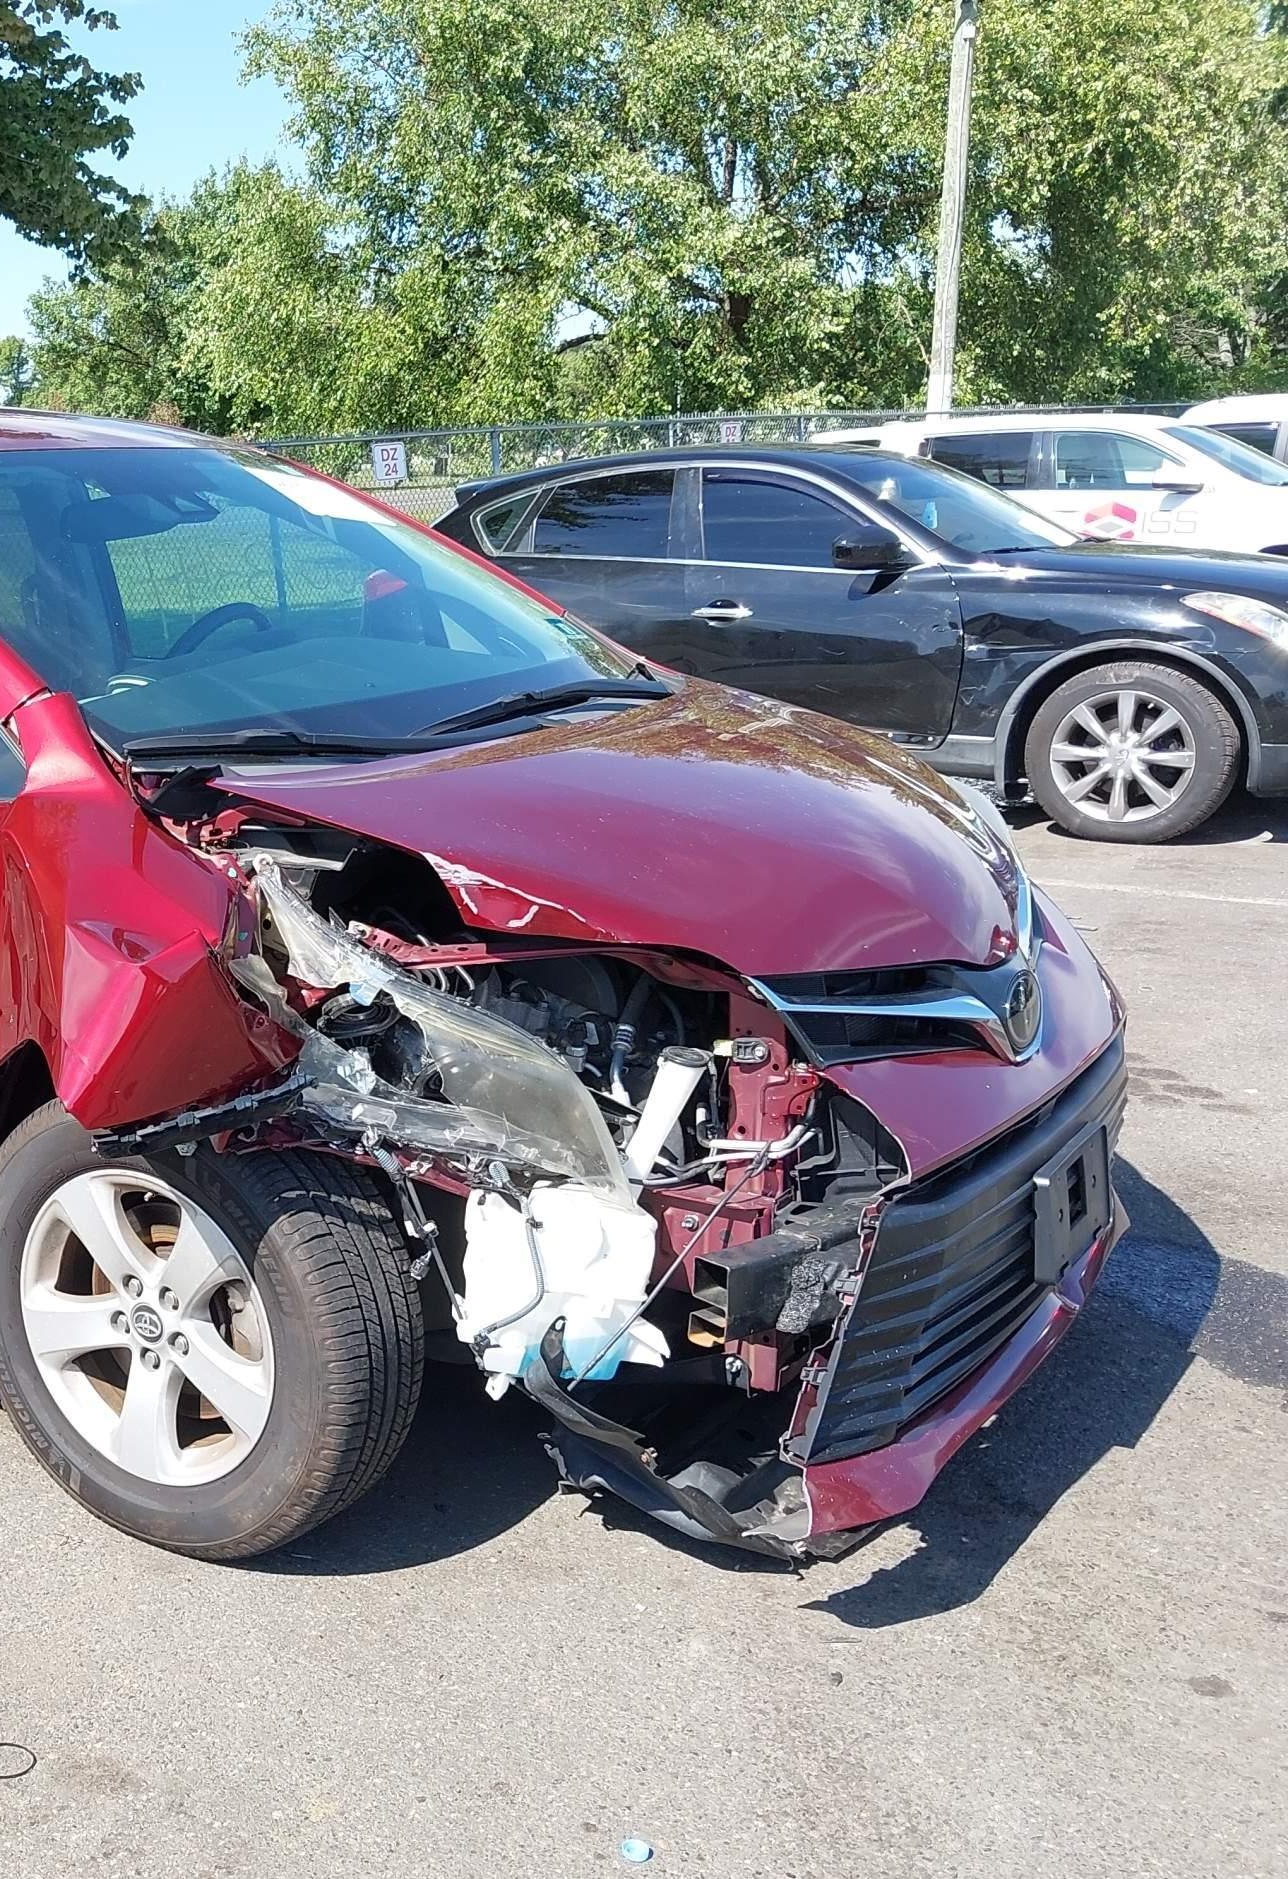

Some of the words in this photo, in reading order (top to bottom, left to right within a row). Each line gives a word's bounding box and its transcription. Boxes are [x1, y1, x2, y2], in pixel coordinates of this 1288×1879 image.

[725, 425, 737, 438] DZ
[380, 447, 399, 462] DZ
[383, 463, 399, 477] 24
